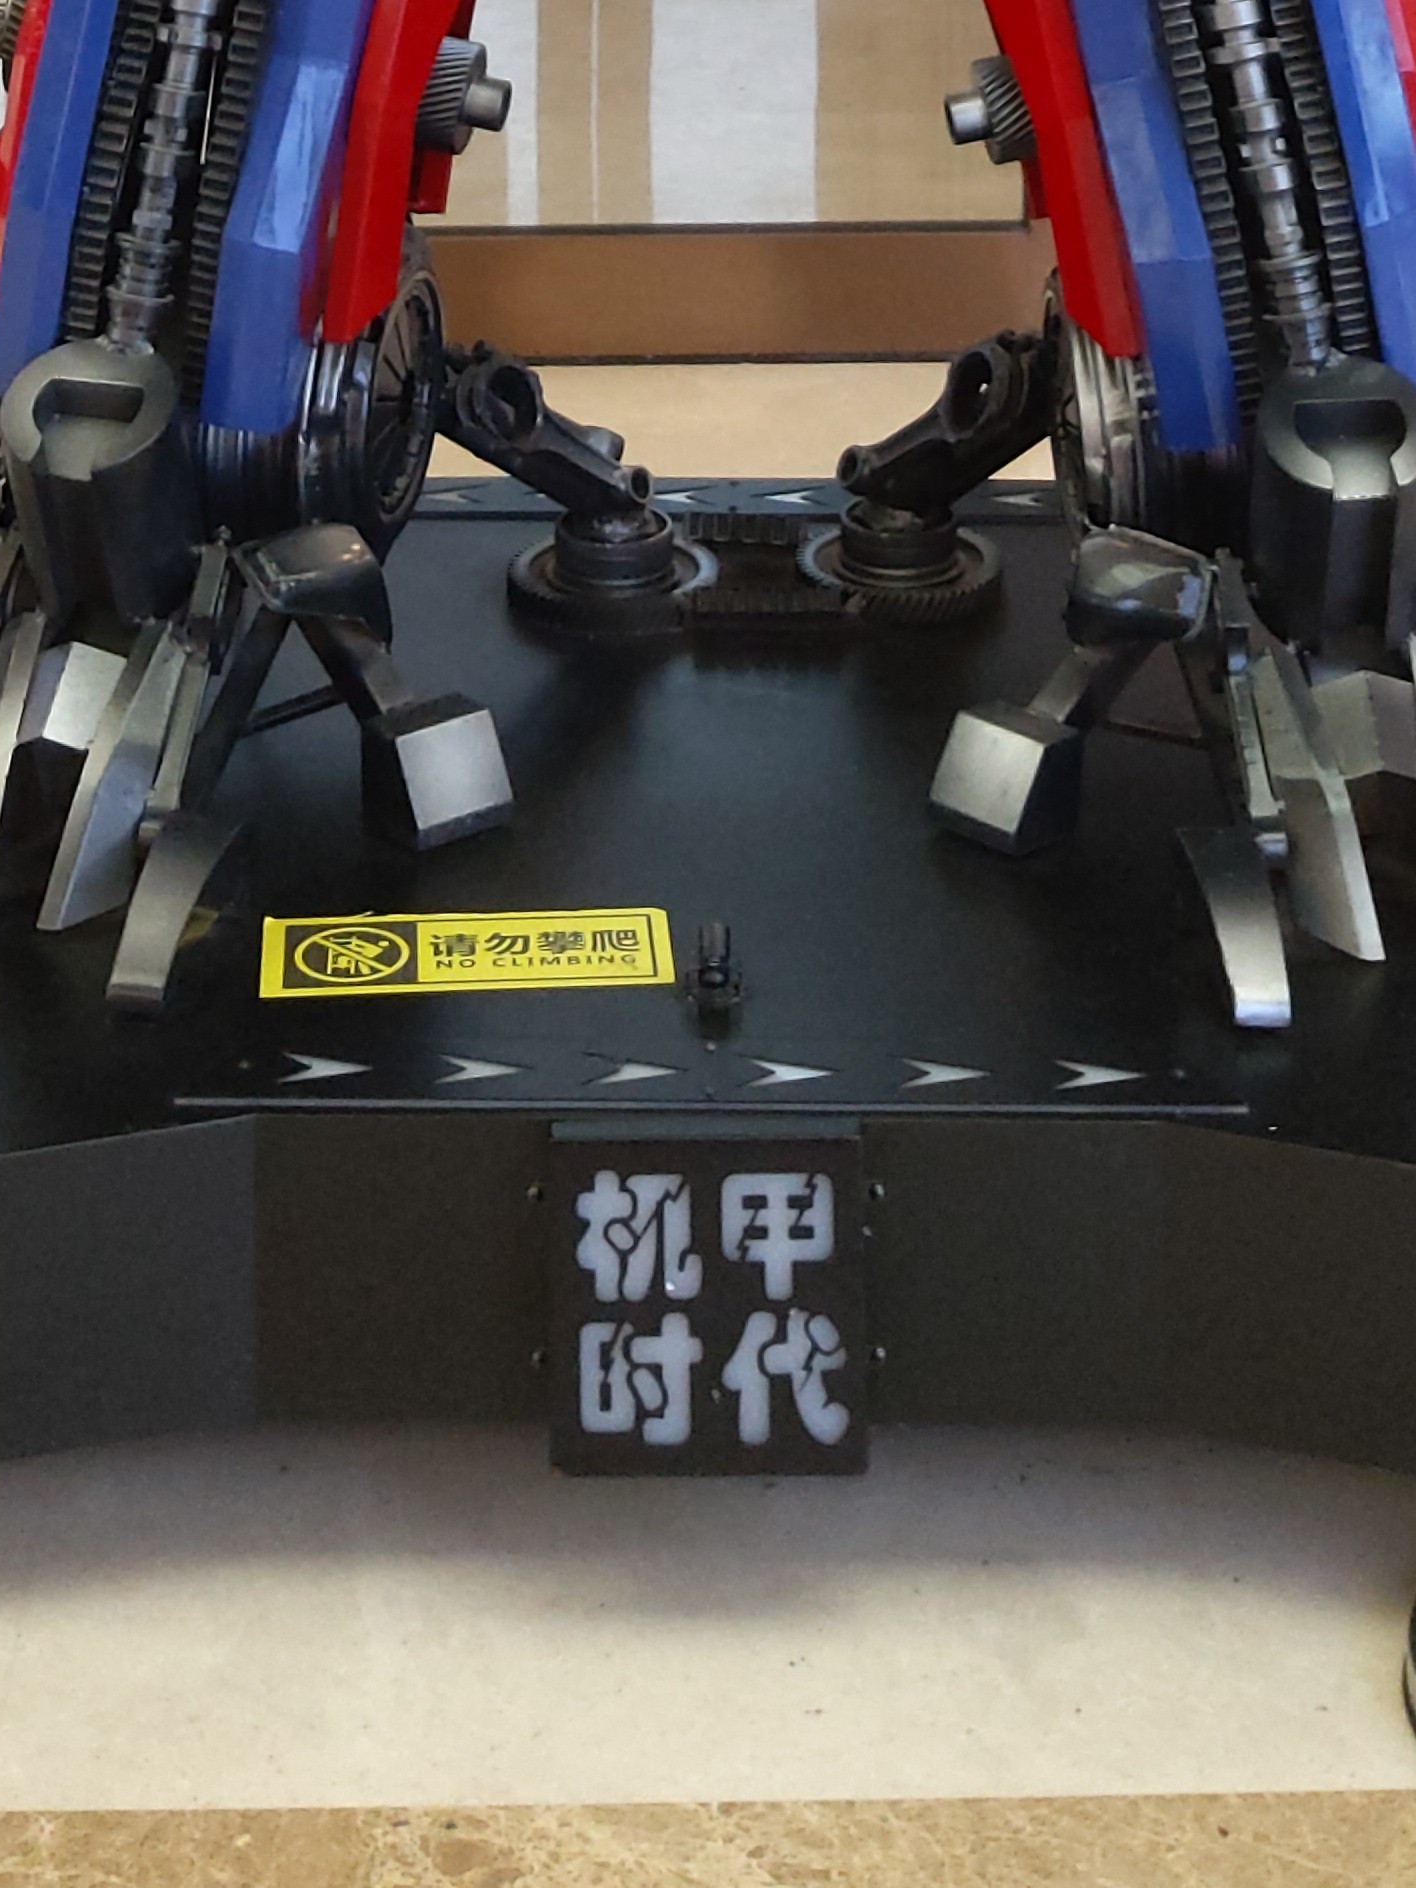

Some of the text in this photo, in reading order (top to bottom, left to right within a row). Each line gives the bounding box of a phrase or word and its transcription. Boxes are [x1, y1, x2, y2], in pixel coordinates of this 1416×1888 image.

[430, 929, 641, 958] 请勿攀爬
[435, 954, 637, 969] NO CLIMBING
[575, 1169, 835, 1303] 机甲
[579, 1307, 850, 1446] 时代
